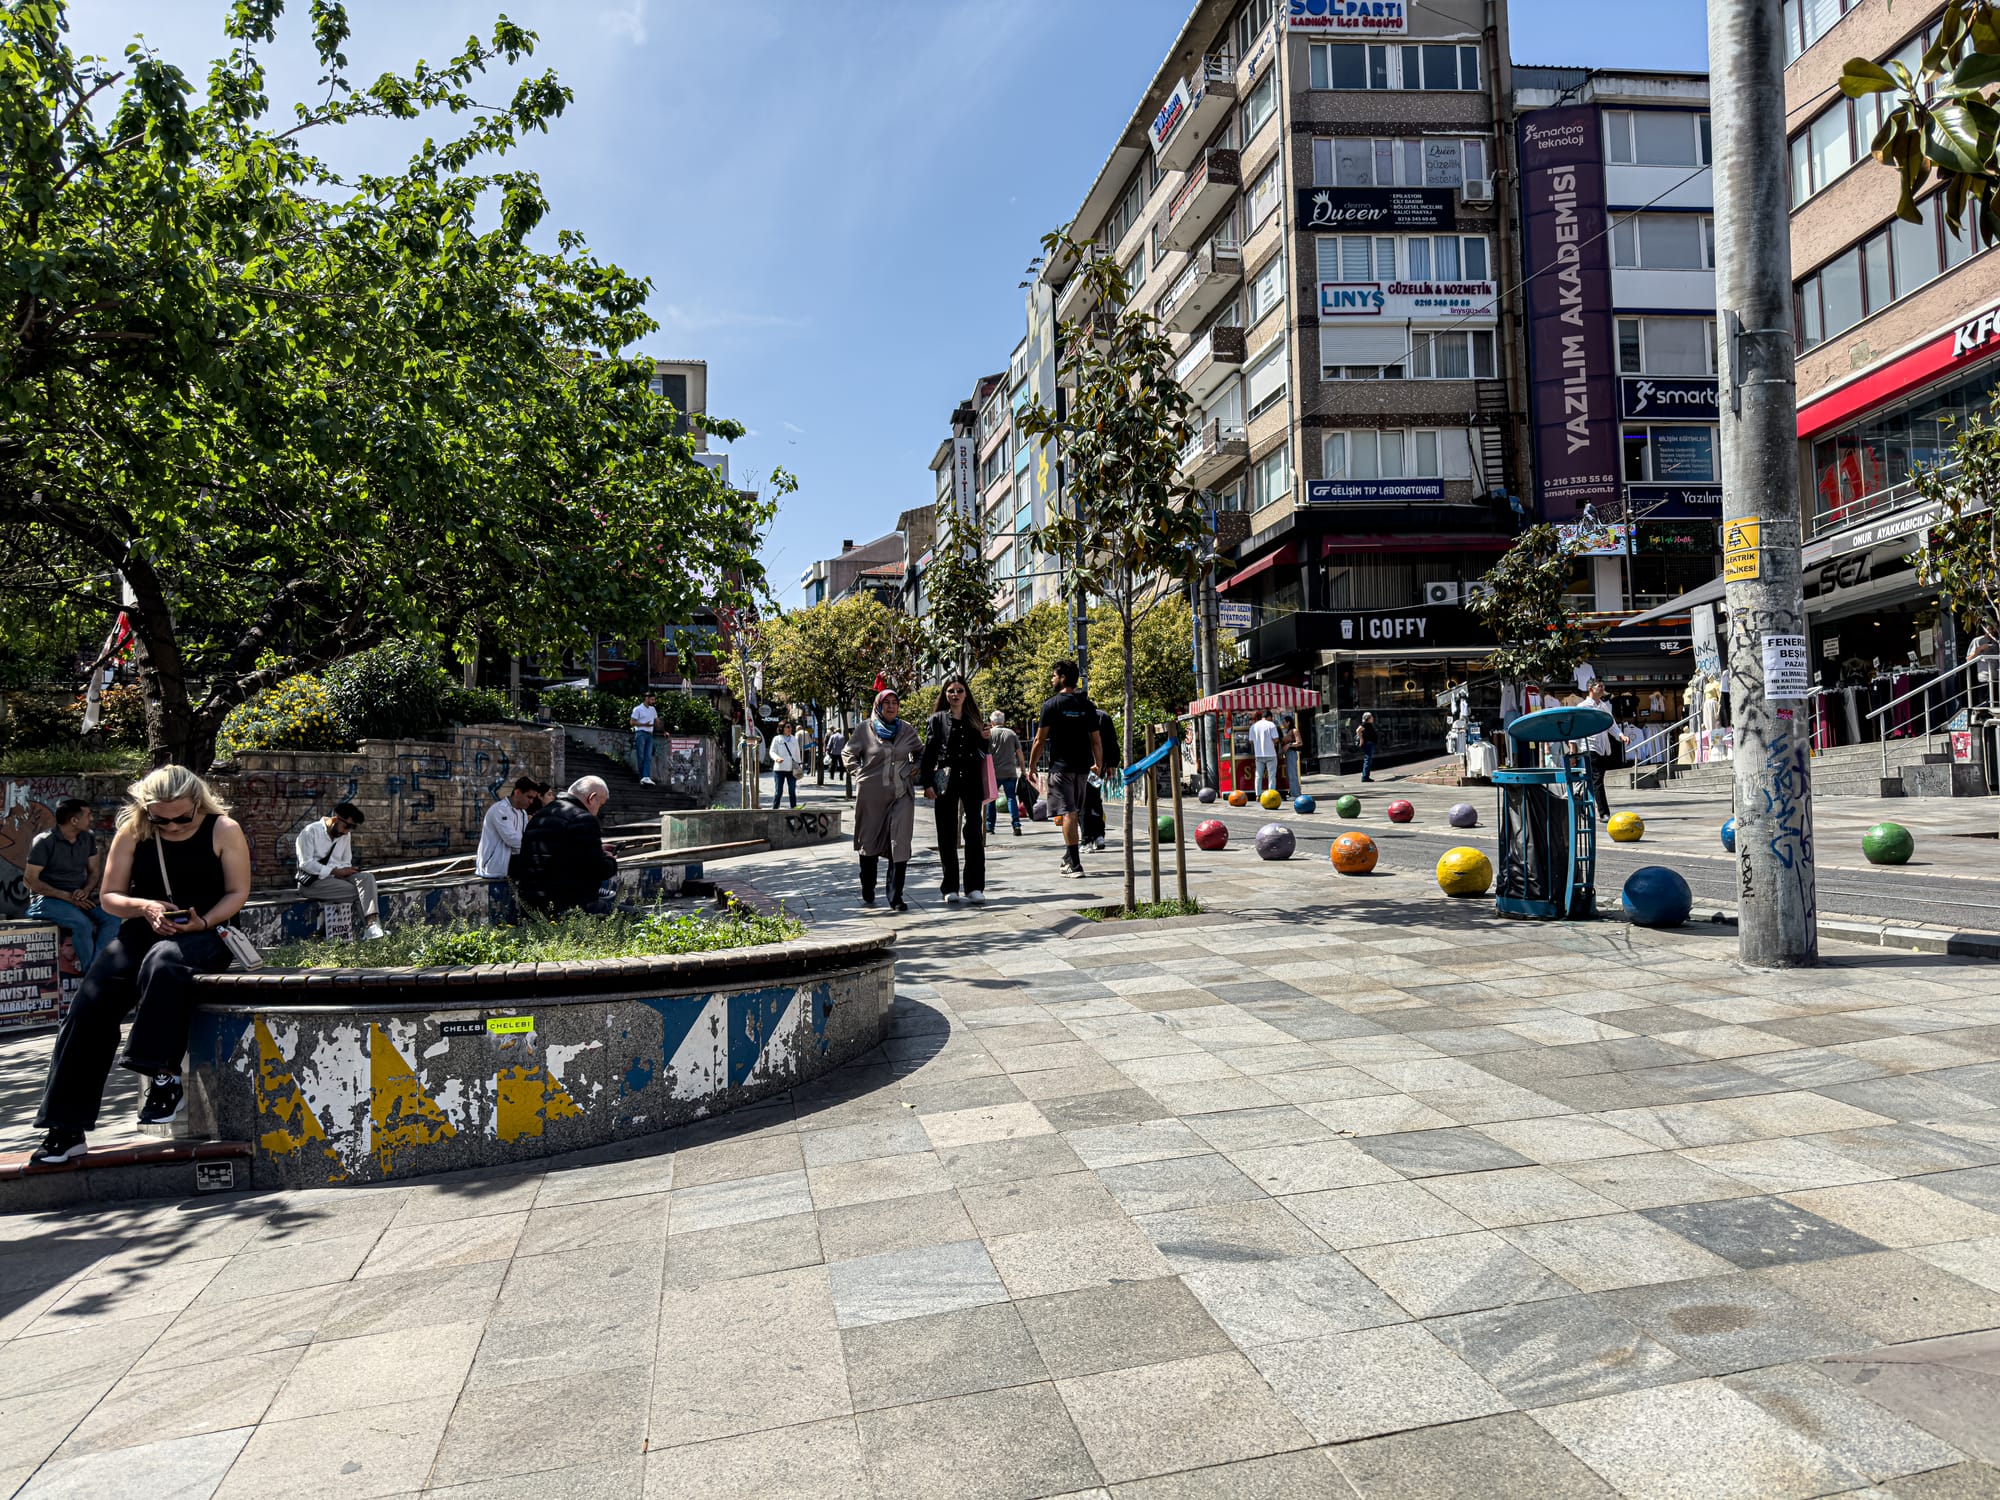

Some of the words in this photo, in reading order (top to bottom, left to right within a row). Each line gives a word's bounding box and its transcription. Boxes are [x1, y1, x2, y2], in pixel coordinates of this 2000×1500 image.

[1290, 16, 1334, 27] KADIKÖY
[1337, 16, 1359, 28] İLÇE
[1362, 16, 1403, 28] ÖRGÜTÜ
[1532, 125, 1584, 140] smartpro
[1538, 134, 1584, 150] teknoloji
[1308, 200, 1383, 226] Queen
[1547, 165, 1584, 327] AKADEMİSİ
[1388, 281, 1434, 295] GÜZELLİK
[1444, 281, 1492, 295] KOZMETİK
[1563, 335, 1591, 455] YAZILIM
[1552, 477, 1569, 486] 216
[1569, 476, 1587, 484] 338
[1588, 475, 1600, 483] 55
[1602, 474, 1614, 482] 66
[1331, 485, 1362, 498] GELİŞİM
[1364, 486, 1377, 496] TIP
[1379, 485, 1440, 496] LABORATUVARI
[1544, 486, 1615, 498] smartpro.com.tr
[1681, 490, 1723, 504] Yazılım
[1852, 531, 1872, 546] ONUR
[1820, 552, 1871, 593] SEZ
[1220, 612, 1250, 622] TİYATROSU
[1370, 618, 1427, 639] COFFY
[1659, 641, 1680, 650] SEZ
[26, 942, 54, 952] SAVAŞA
[24, 951, 54, 962] FAŞİZME
[26, 966, 52, 980] YOK!
[443, 1024, 484, 1032] CHELEBI
[490, 1021, 530, 1029] CHELEBI
